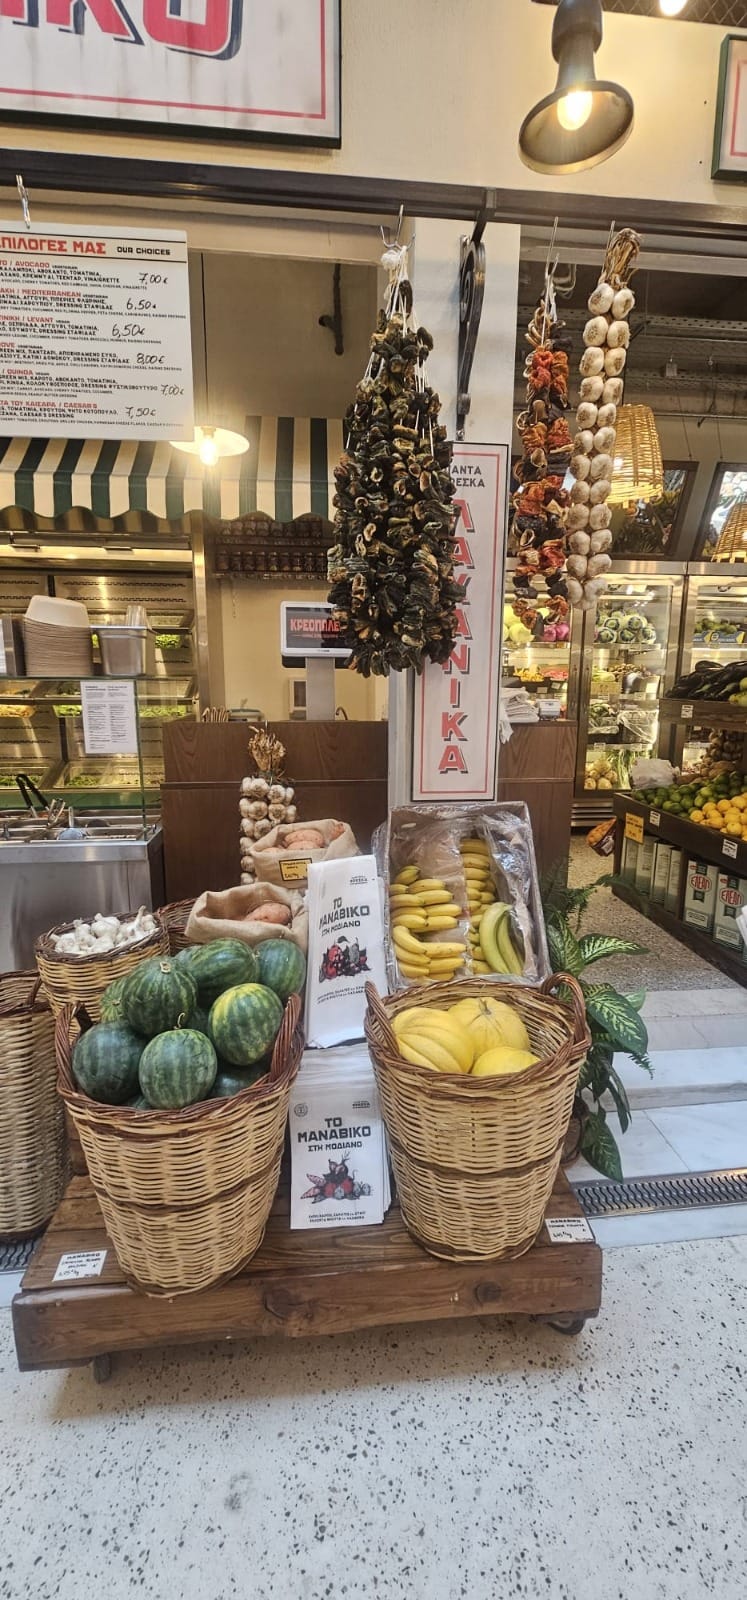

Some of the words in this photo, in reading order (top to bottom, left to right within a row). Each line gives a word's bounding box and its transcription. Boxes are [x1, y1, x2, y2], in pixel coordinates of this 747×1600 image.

[0, 237, 67, 252] ΠΙΛΟΓΕΣ
[73, 240, 106, 255] ΜΑΣ
[136, 247, 171, 255] CHOICES
[16, 260, 50, 268] AVOCADO
[22, 289, 81, 297] MEDITERRANEAN
[450, 477, 485, 488] ΡΕΣΚΑ
[333, 897, 343, 910] ΤΟ
[324, 1117, 342, 1128] ΤΟ
[297, 1126, 371, 1143] ΜΑΝΑΒΙΚΟ
[325, 1141, 362, 1151] ΜΟΔΙΑΝΟ
